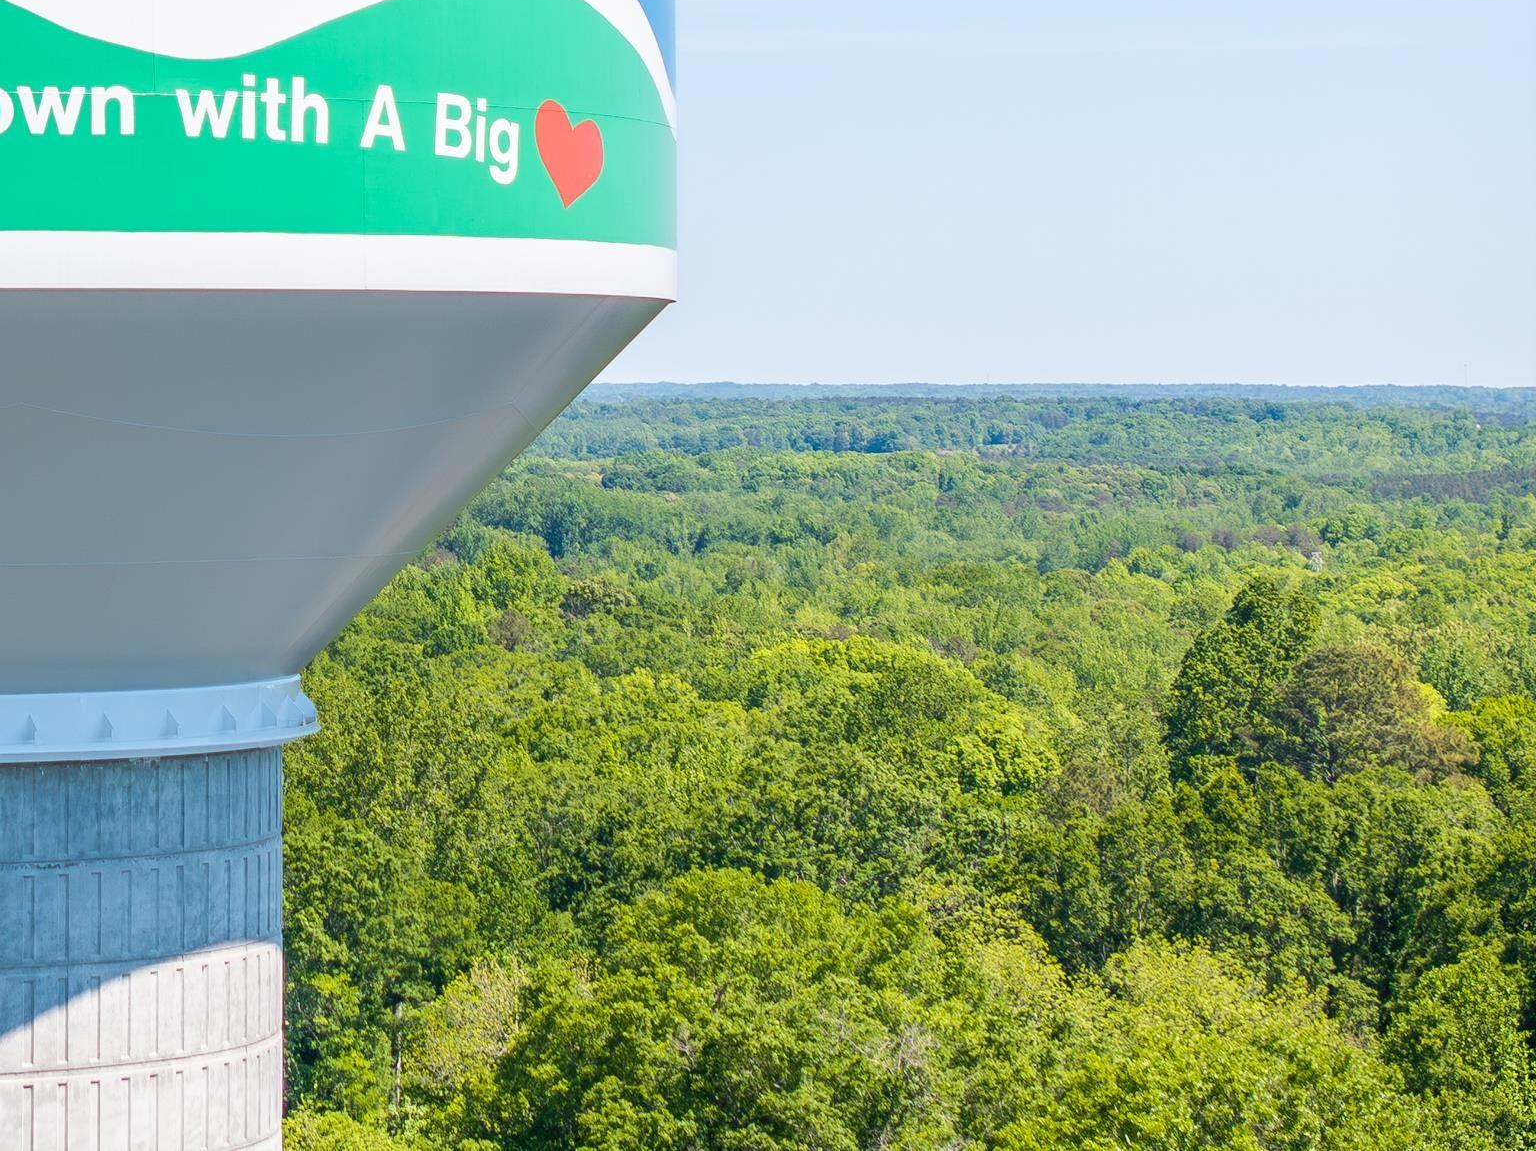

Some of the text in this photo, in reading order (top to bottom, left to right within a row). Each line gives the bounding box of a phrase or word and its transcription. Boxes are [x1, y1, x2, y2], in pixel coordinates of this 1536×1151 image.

[175, 74, 331, 145] with
[360, 85, 407, 152] A
[434, 92, 520, 185] Big
